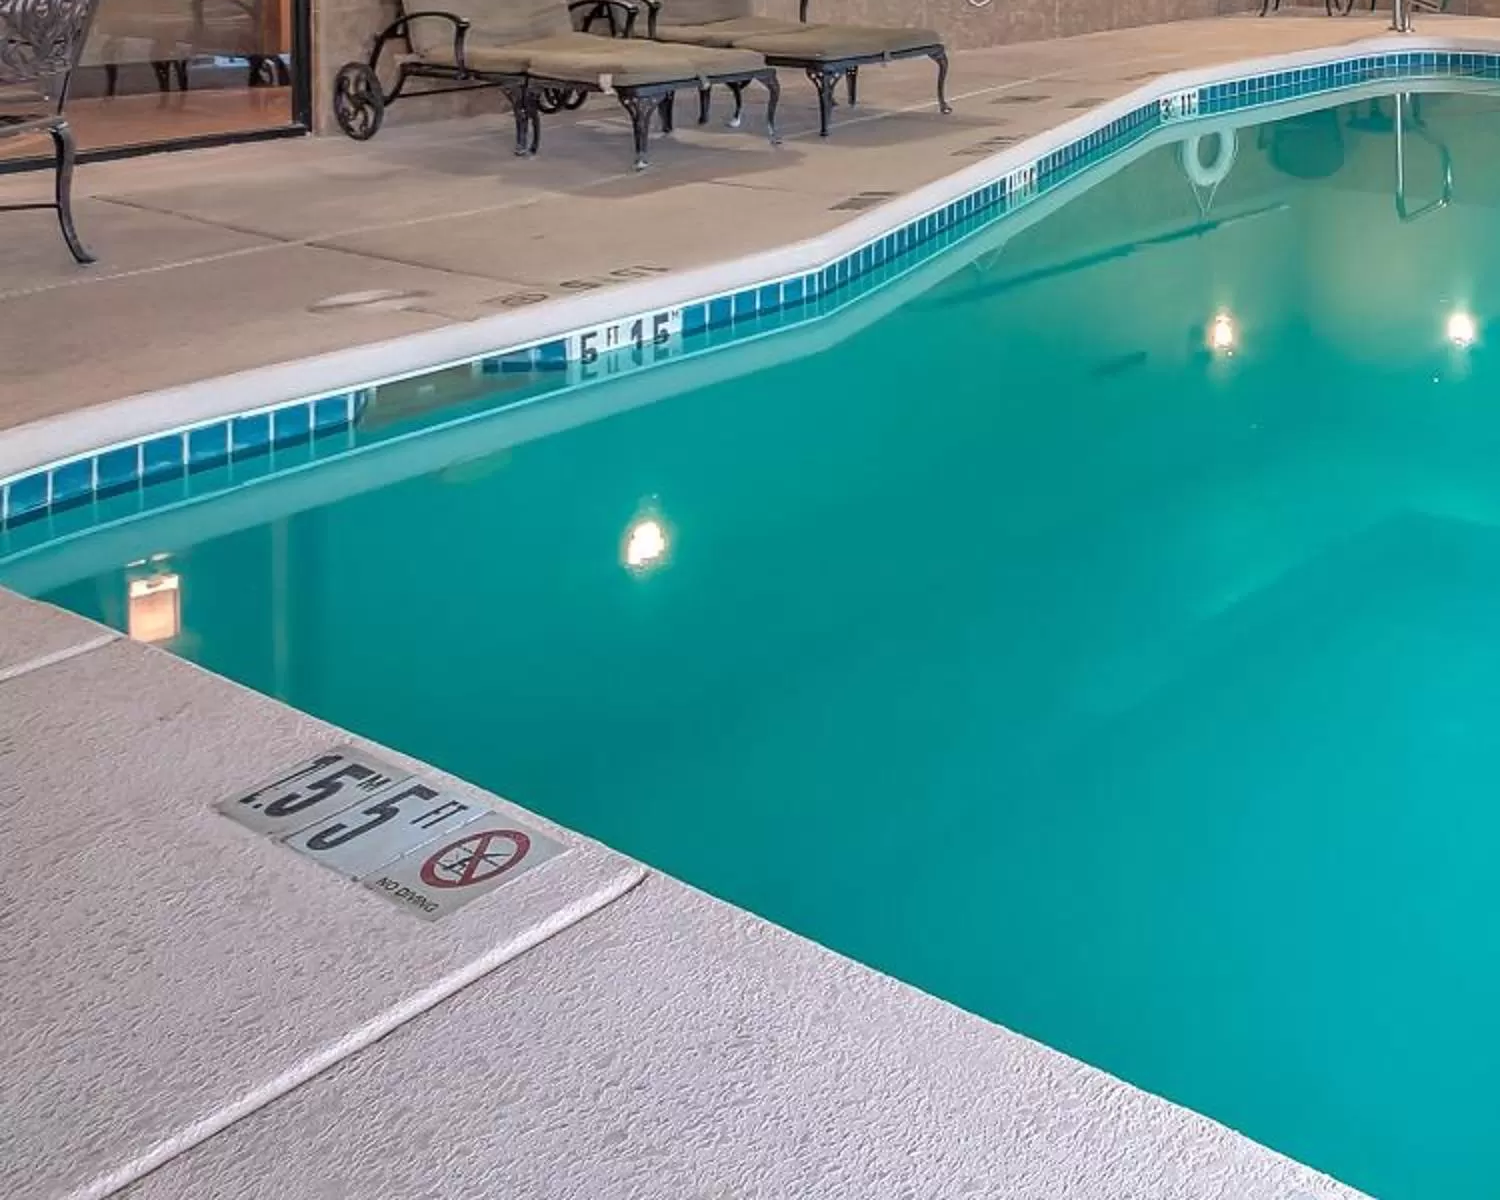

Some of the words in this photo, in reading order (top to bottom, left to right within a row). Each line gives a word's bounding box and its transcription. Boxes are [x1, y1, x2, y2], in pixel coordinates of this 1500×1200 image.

[581, 331, 598, 365] 5
[240, 754, 377, 818] 1.5
[305, 783, 439, 851] 5
[410, 799, 469, 829] FT
